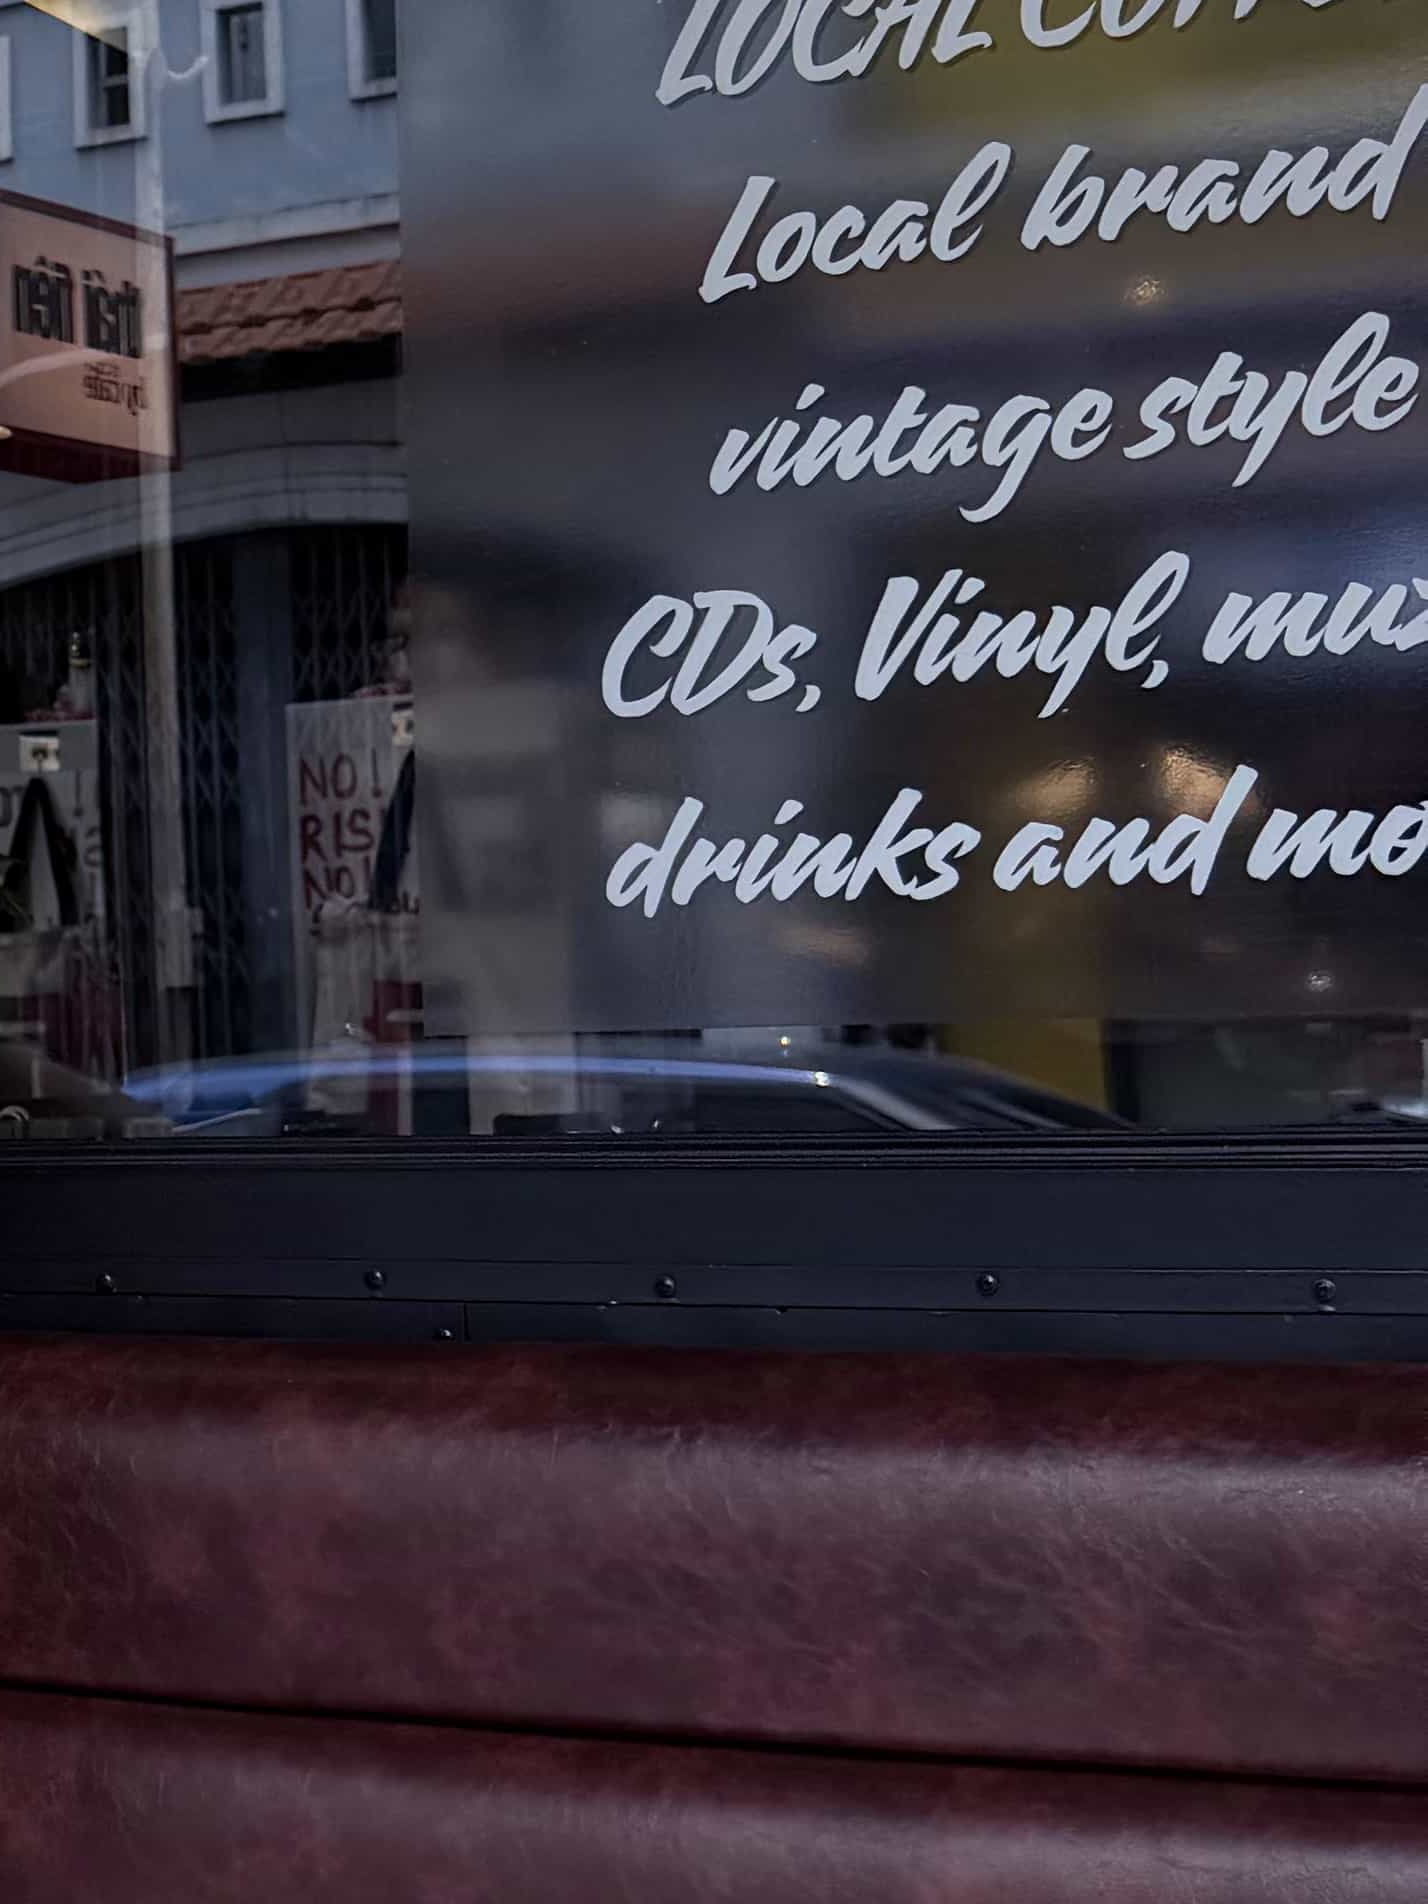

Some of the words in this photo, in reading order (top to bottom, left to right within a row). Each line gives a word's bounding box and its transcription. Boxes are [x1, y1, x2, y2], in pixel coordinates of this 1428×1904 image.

[699, 141, 1011, 303] Local
[1021, 83, 1428, 251] brand
[708, 384, 1113, 521] vintage
[1123, 312, 1419, 487] style
[602, 589, 821, 716] CDs,
[853, 551, 1190, 717] Vinyl,
[301, 810, 386, 864] RIS
[605, 788, 980, 917] drinks
[993, 764, 1256, 895] and
